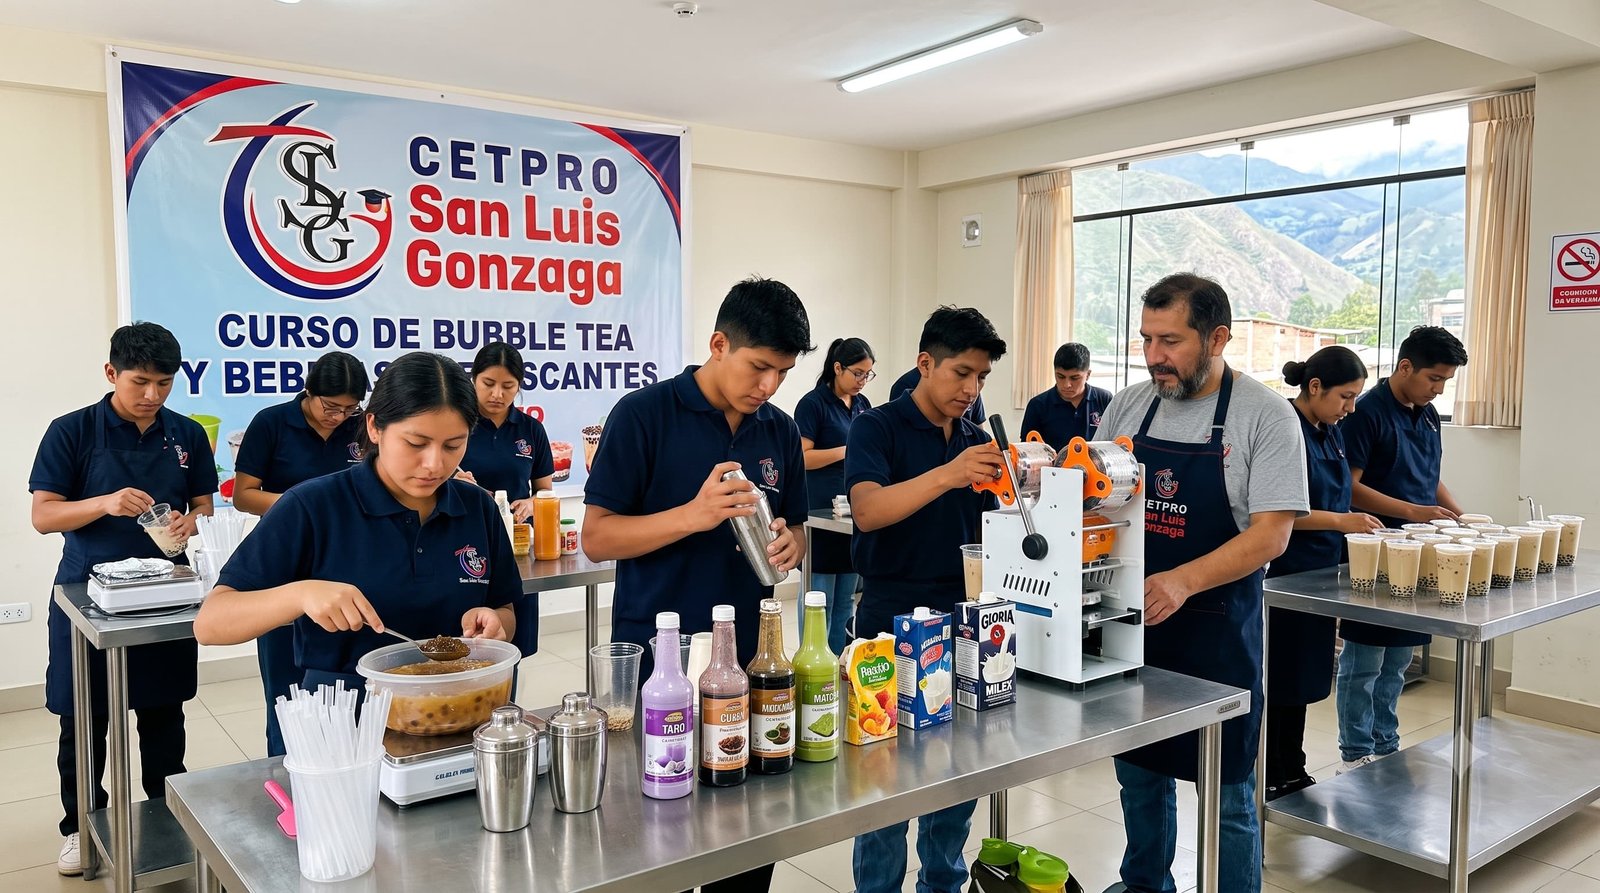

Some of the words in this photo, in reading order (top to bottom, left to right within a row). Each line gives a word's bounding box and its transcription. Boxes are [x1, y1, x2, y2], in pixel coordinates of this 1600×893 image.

[409, 136, 618, 195] CETPRO
[409, 185, 509, 238] San
[525, 196, 621, 246] Luis
[406, 239, 622, 305] Gonzaga
[218, 314, 359, 349] CURSO
[373, 318, 420, 348] DE
[433, 319, 566, 350] BUBBLE
[576, 323, 634, 351] TEA
[181, 361, 209, 394] Y
[1144, 499, 1187, 514] ETPRO
[1145, 511, 1158, 520] an
[1161, 512, 1186, 526] Luis
[1144, 522, 1185, 538] onzaga
[981, 609, 1015, 629] GLORIA
[986, 680, 1013, 696] MILEX
[662, 723, 685, 734] TARO
